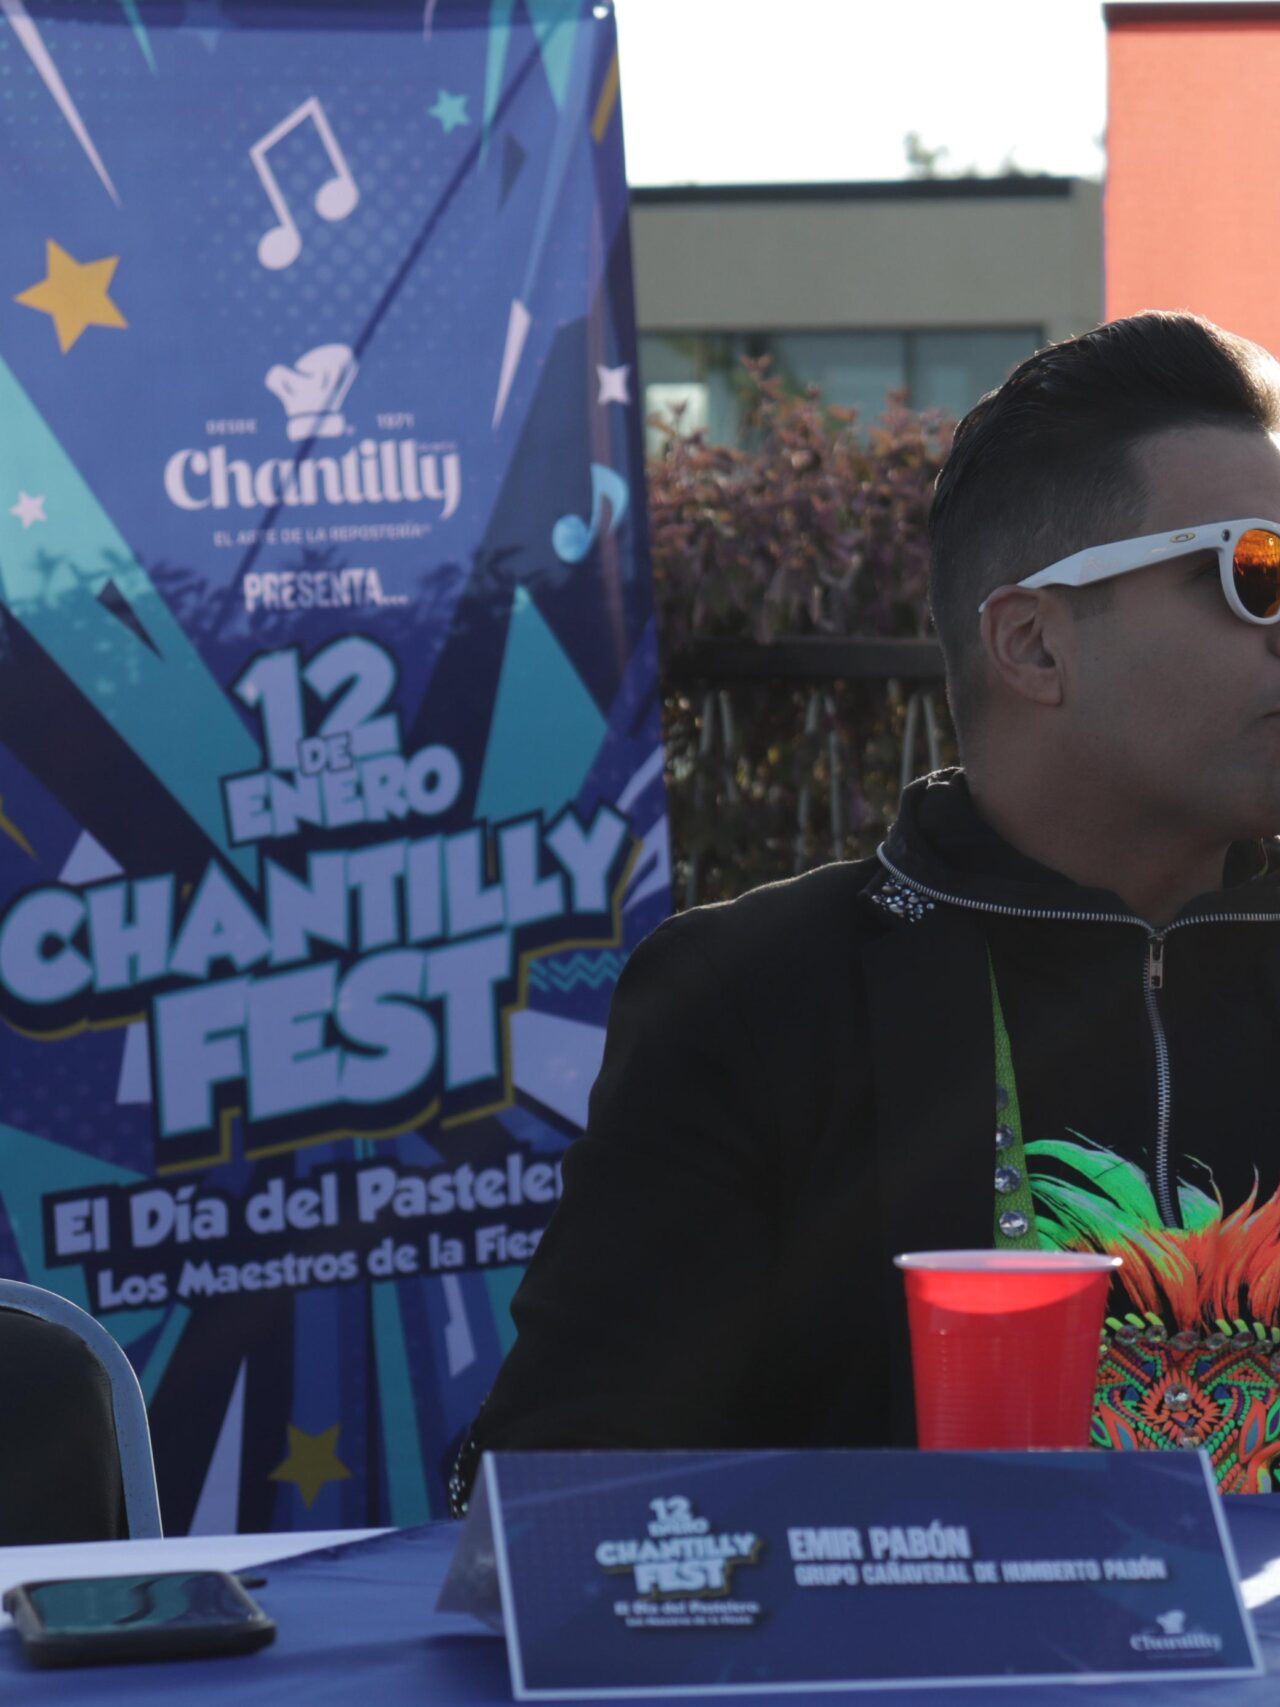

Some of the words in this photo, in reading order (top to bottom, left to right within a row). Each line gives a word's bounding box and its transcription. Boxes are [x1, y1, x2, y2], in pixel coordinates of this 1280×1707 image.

[164, 439, 461, 520] Chantilly
[280, 527, 303, 545] DE
[306, 525, 327, 543] LA
[234, 635, 400, 769] 12
[298, 731, 353, 777] DE
[224, 743, 462, 843] ENERO
[0, 808, 629, 1003] CHANTILLY
[155, 932, 513, 1138] FEST
[54, 1198, 109, 1255] El
[130, 1182, 227, 1248] Día
[245, 1172, 339, 1234] del
[98, 1268, 167, 1308] Los
[177, 1250, 359, 1300] Maestros
[366, 1237, 418, 1276] de
[428, 1232, 464, 1269] la
[649, 1495, 692, 1521] 12
[595, 1531, 756, 1566] CHANTILLY
[788, 1526, 862, 1560] EMIR
[868, 1519, 972, 1560] PABÓN
[795, 1563, 859, 1586] GRUPO
[862, 1559, 971, 1585] CAÑAVERAL
[973, 1562, 999, 1583] DE
[1001, 1559, 1100, 1583] HUMBERTO
[1102, 1554, 1168, 1581] PABÓN
[634, 1558, 726, 1593] FEST
